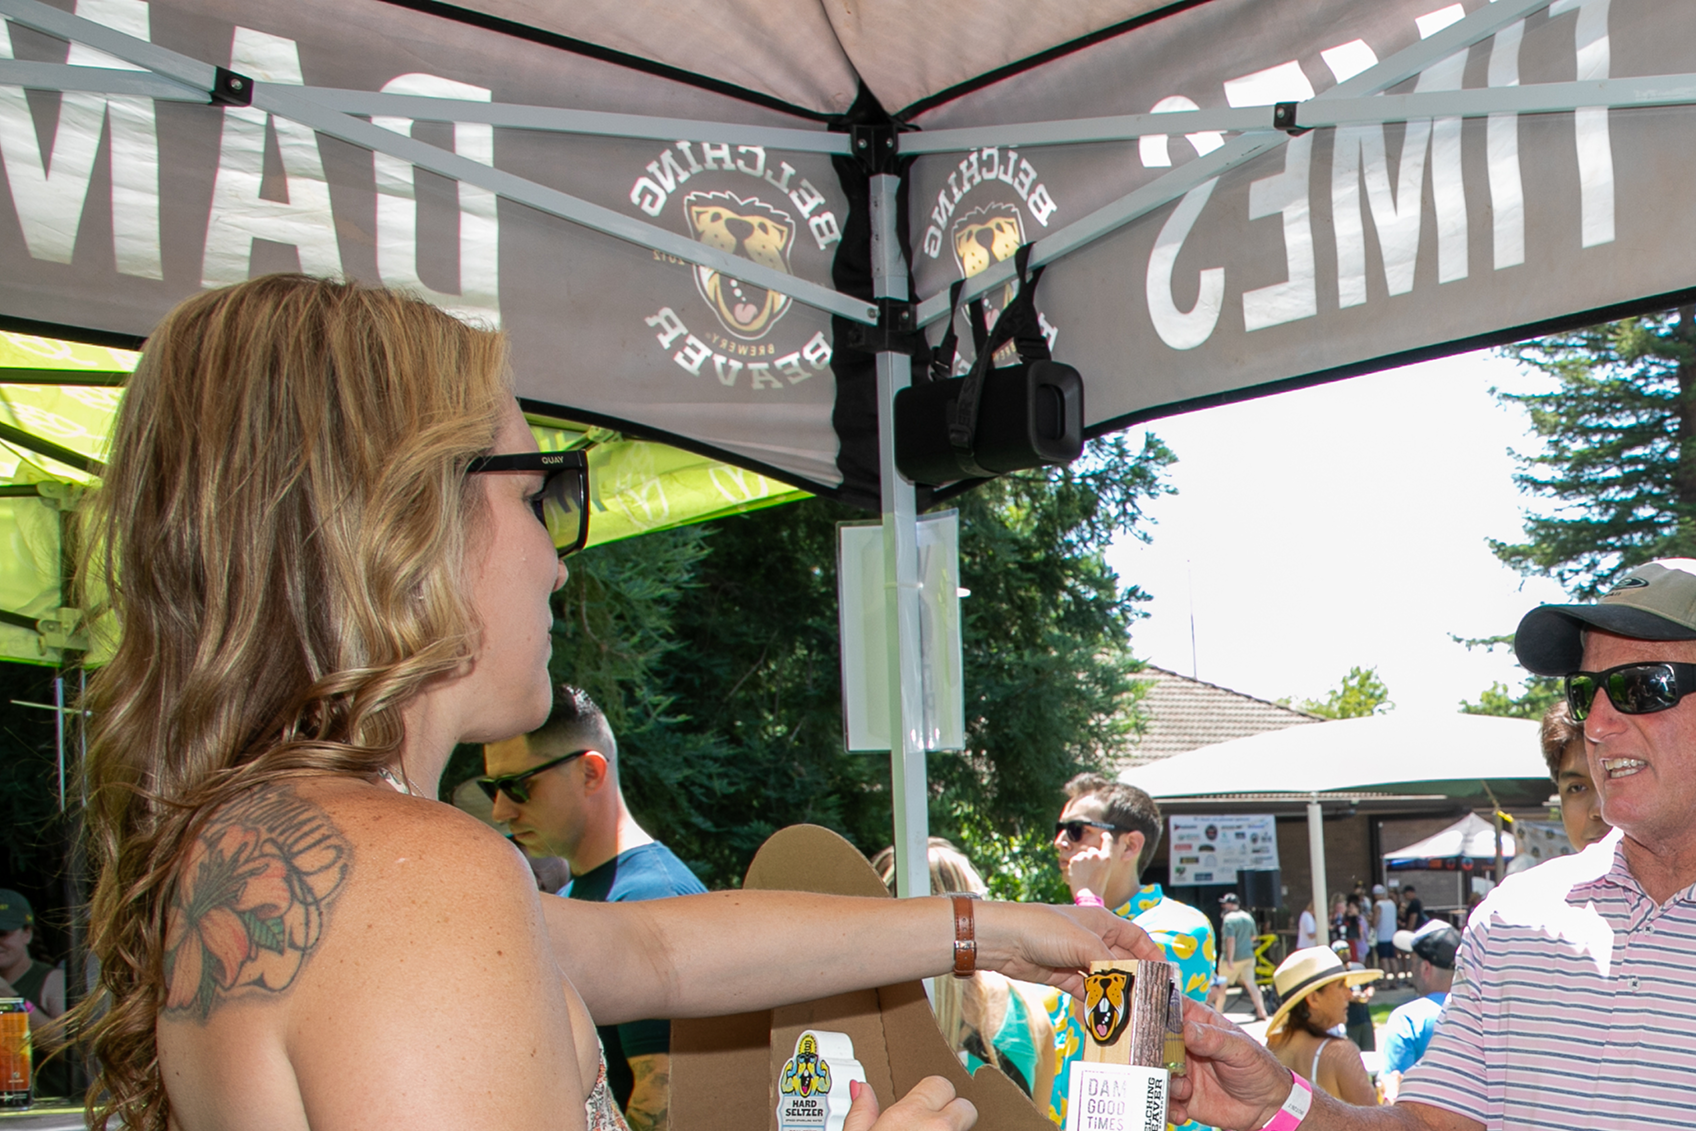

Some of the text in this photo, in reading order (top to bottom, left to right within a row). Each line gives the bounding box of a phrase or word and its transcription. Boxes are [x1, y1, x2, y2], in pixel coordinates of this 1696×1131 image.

[541, 455, 564, 465] QUAY
[1087, 1078, 1128, 1098] DAM
[792, 1099, 817, 1108] HARD
[1087, 1098, 1126, 1116] GOOD
[785, 1108, 824, 1117] SELTZER
